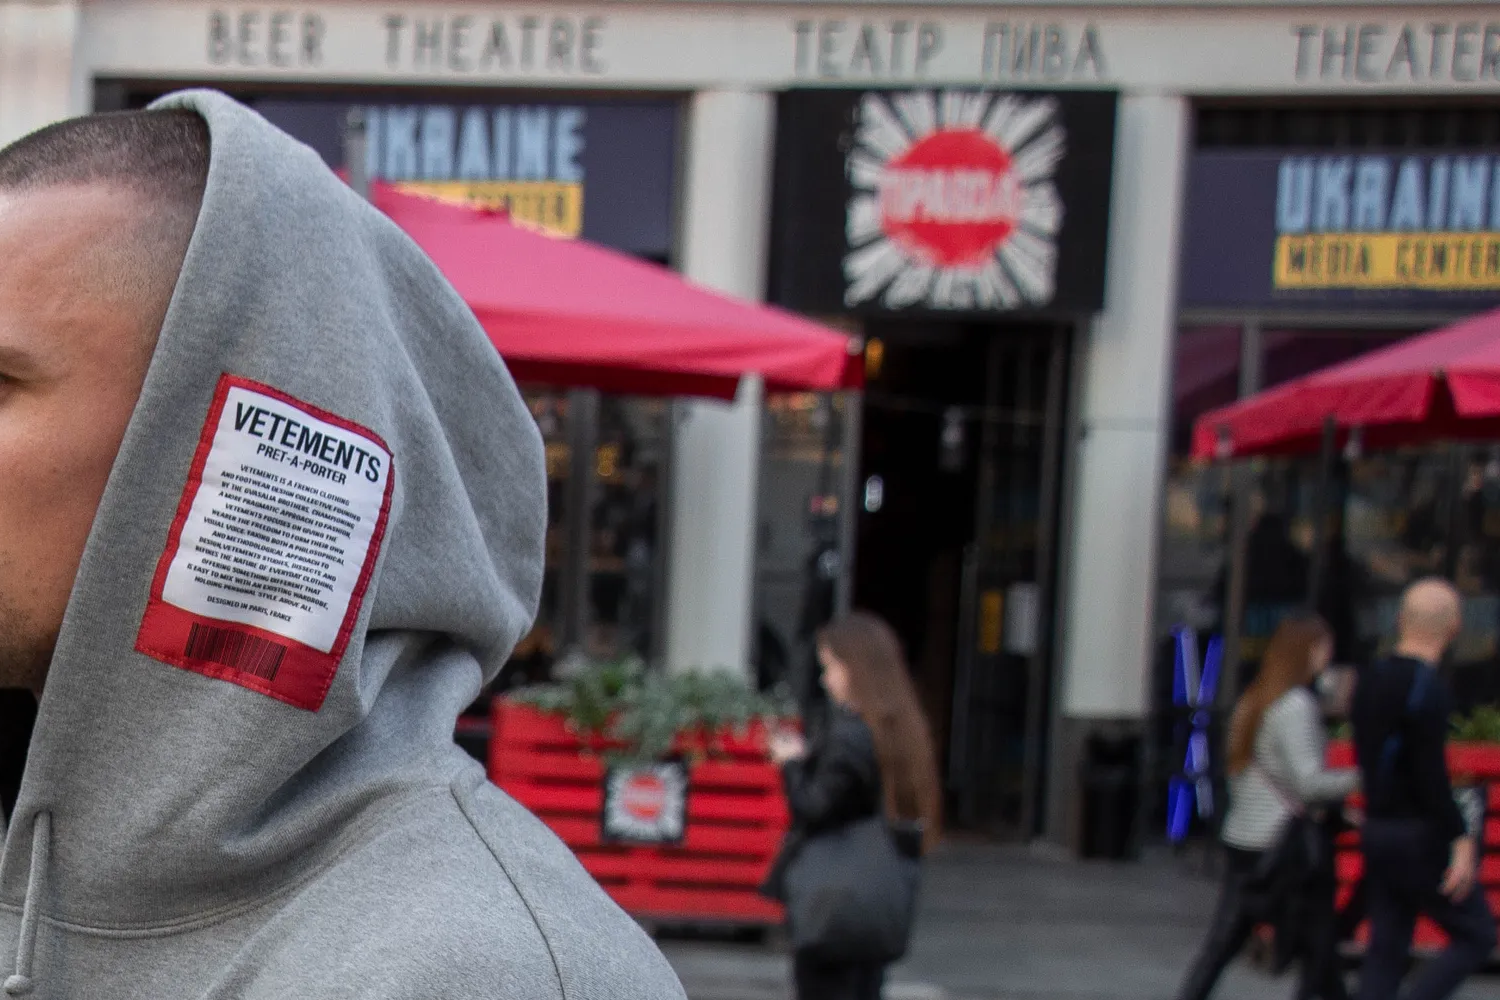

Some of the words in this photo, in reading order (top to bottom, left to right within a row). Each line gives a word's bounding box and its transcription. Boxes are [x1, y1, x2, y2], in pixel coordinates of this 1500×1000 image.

[207, 10, 325, 66] BEER
[383, 13, 607, 72] THEATRE
[788, 20, 944, 78] ТЕАТР
[983, 22, 1107, 80] ПИВА
[1291, 23, 1500, 82] THEATER
[1277, 156, 1500, 232] UKRAIN
[1288, 241, 1370, 278] MEDIA
[234, 402, 380, 483] VETEMENTS
[256, 444, 347, 485] PRET-A-PORTER
[221, 470, 235, 479] AND
[235, 475, 271, 490] FOOTWEAR
[271, 486, 294, 498] DESIGN
[333, 506, 361, 522] FOUNDED
[232, 484, 243, 492] THE
[294, 482, 319, 495] FRENCH
[319, 491, 350, 506] CLOTHING
[224, 492, 241, 502] MORE
[280, 509, 314, 525] APPROACH
[203, 517, 225, 528] VISUAL
[247, 530, 271, 542] TAKING
[271, 537, 289, 548] BOTH
[211, 509, 237, 521] WEARER
[238, 517, 250, 525] THE
[251, 521, 282, 535] FREEDOM
[291, 534, 310, 544] FORM
[311, 540, 329, 550] THEIR
[329, 546, 344, 555] OWN
[263, 515, 291, 528] FOCUSES
[303, 527, 325, 539] GIVING
[326, 534, 337, 542] THE
[212, 530, 227, 539] AND
[286, 552, 320, 567] APPROACH
[220, 553, 232, 561] THE
[233, 557, 257, 568] NATURE
[269, 567, 302, 580] EVERYDAY
[194, 565, 209, 574] EASY
[220, 573, 234, 582] MIX
[234, 577, 252, 586] WITH
[263, 584, 292, 596] EXISTING
[201, 558, 231, 571] OFFERING
[305, 586, 321, 595] THAT
[291, 563, 322, 577] DISSECTS
[323, 573, 337, 582] AND
[195, 576, 223, 589] HOLDING
[223, 584, 256, 596] PERSONAL
[258, 591, 277, 601] STYLE
[279, 597, 300, 608] ABOVE
[207, 596, 240, 608] DESIGNED
[270, 610, 292, 622] FRANCE
